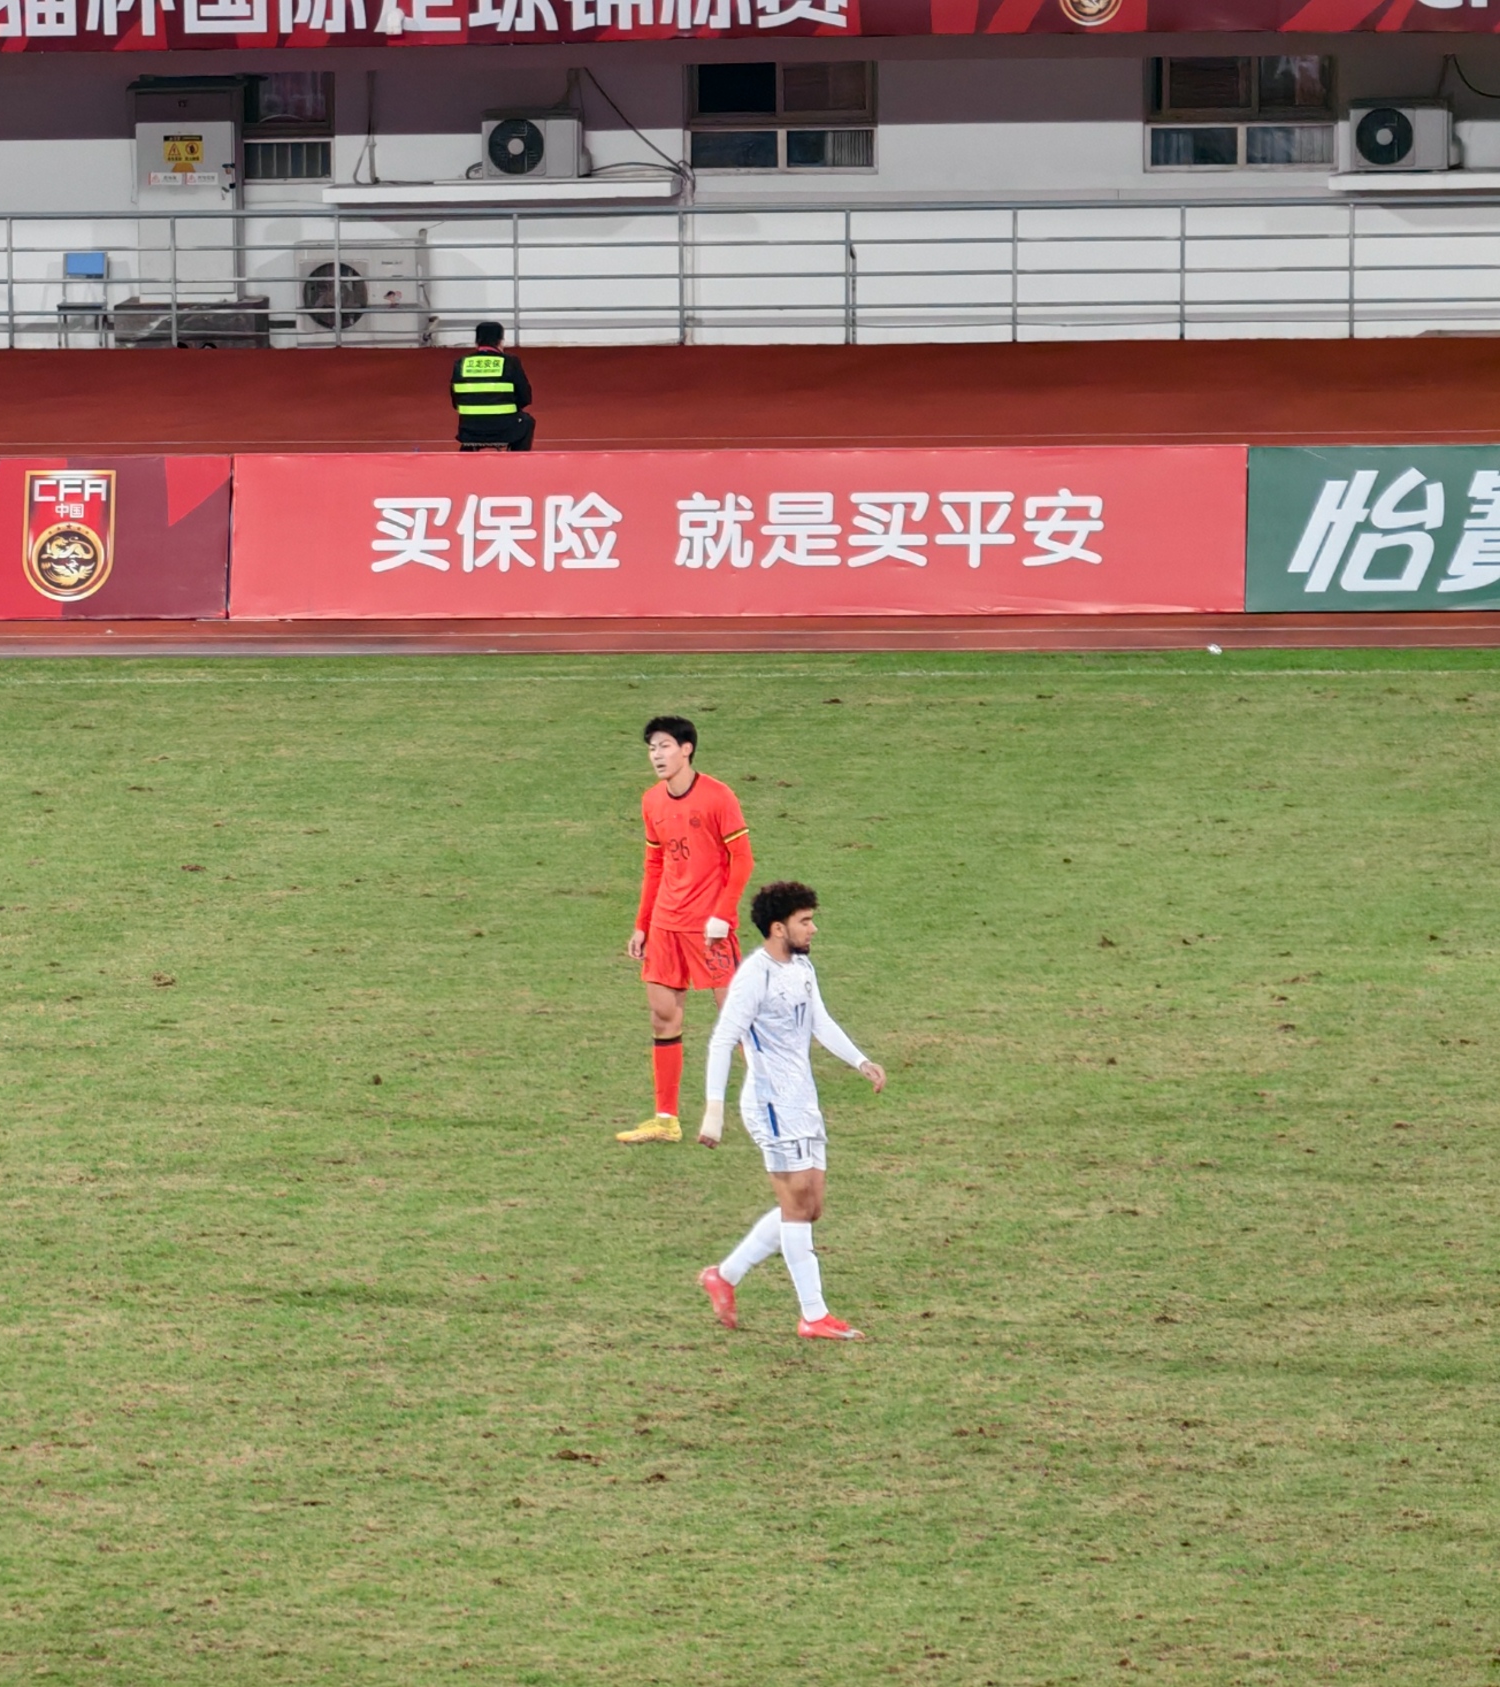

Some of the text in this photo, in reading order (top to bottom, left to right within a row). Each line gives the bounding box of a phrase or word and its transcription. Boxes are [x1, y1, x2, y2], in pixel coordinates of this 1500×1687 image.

[34, 479, 107, 502] CFA
[55, 503, 84, 518] 中国
[371, 488, 1104, 572] 买保险 就是买平安
[668, 837, 690, 861] 26
[795, 1002, 806, 1028] 17
